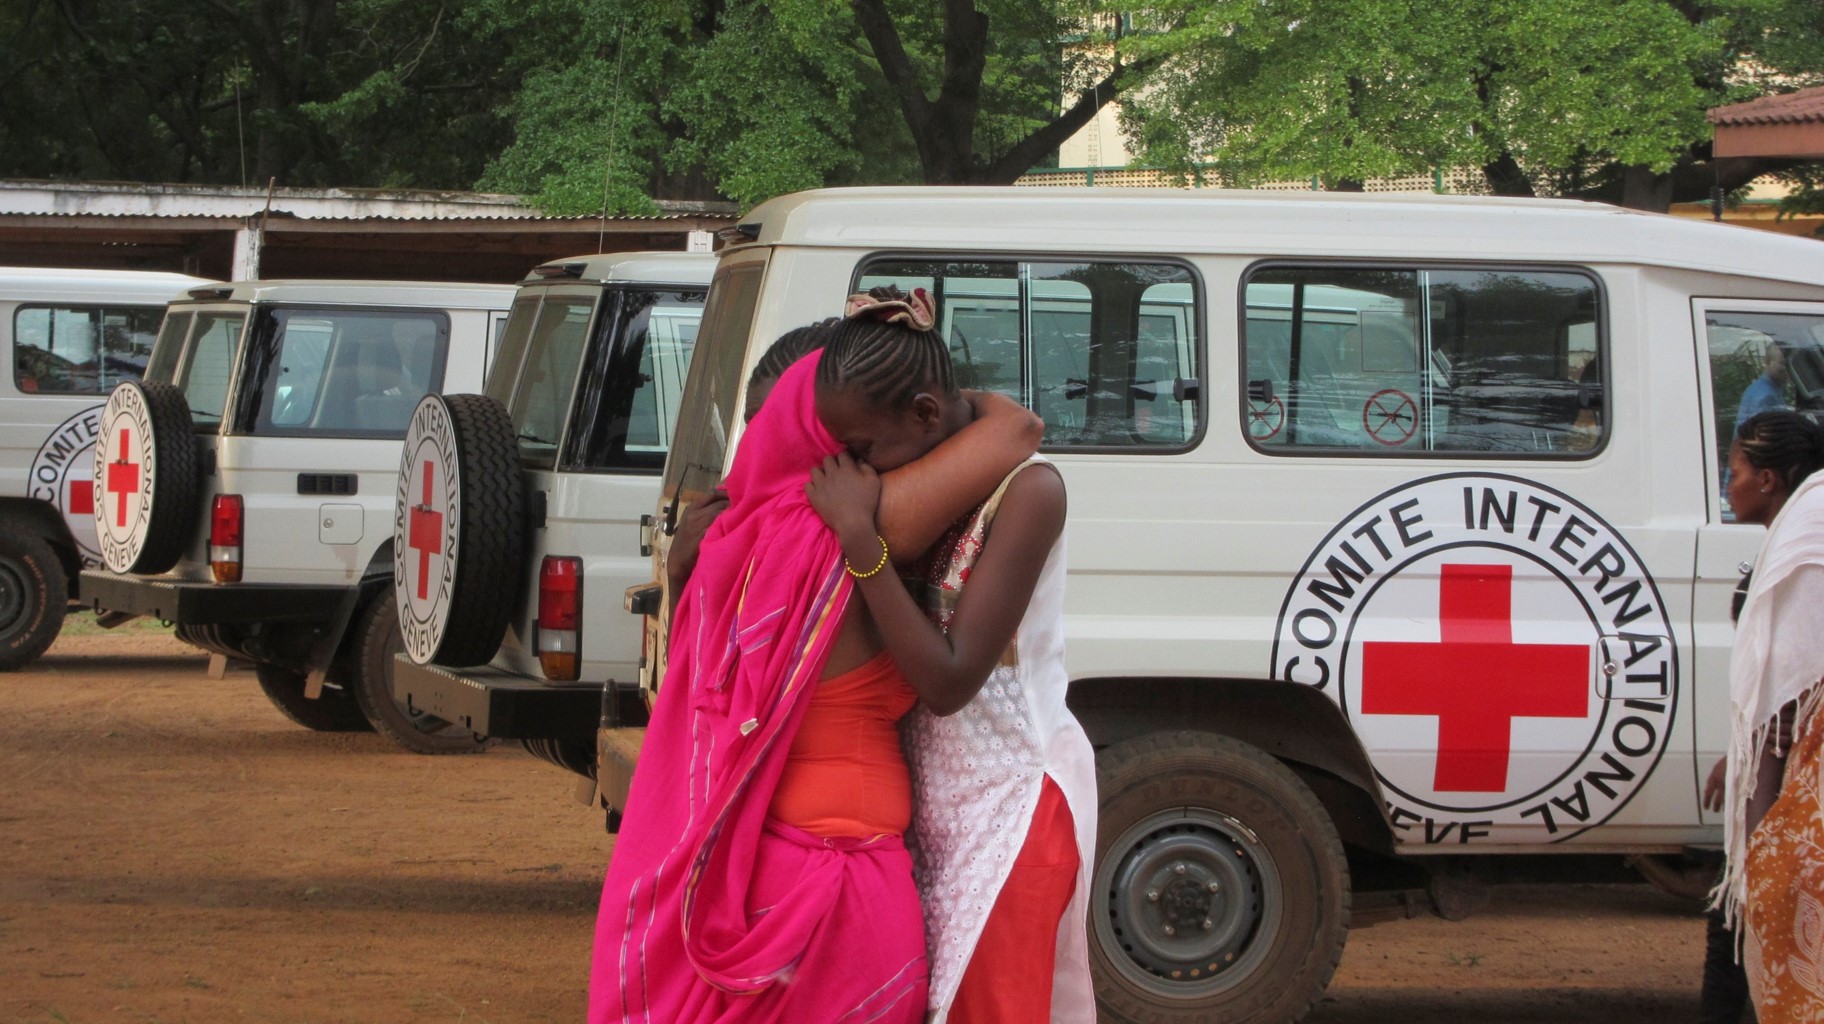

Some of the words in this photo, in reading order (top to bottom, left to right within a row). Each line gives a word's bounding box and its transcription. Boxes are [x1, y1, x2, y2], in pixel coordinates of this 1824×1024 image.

[34, 414, 99, 502] COMITE
[95, 417, 110, 522] COMITE
[111, 388, 153, 525] INTERNATIONAL
[396, 441, 412, 587] COMITE
[415, 402, 457, 601] INTERNATIONAL
[103, 532, 138, 567] GENEVE
[402, 602, 438, 657] GENEVE
[1283, 497, 1434, 690] COMITE
[1462, 486, 1669, 834] INTERNATIONAL
[1385, 800, 1494, 845] EVE
